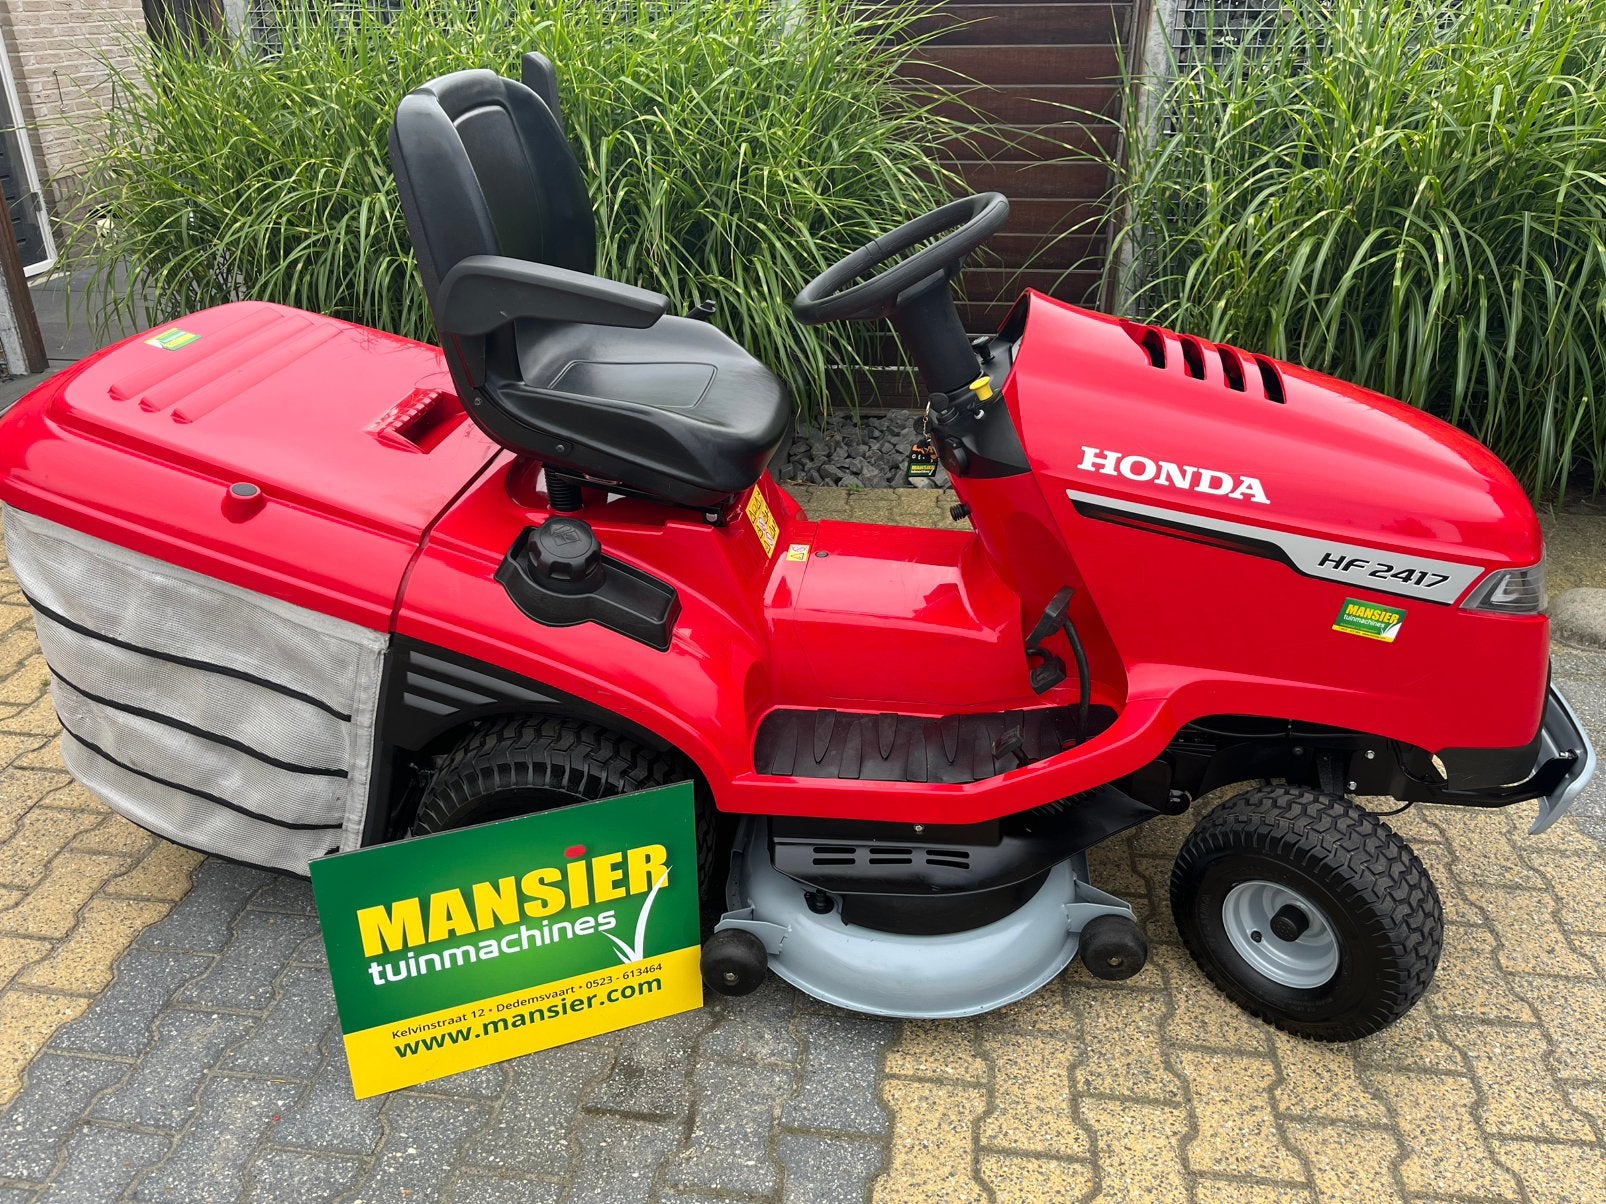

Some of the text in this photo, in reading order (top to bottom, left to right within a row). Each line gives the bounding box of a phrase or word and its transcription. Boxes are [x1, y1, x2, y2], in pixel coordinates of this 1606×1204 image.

[1077, 445, 1271, 505] HONDA
[1317, 552, 1451, 588] HF 2417
[1345, 604, 1400, 624] MANSIER
[356, 844, 669, 958] MANSIER
[368, 909, 616, 986] tuinmachines
[391, 1013, 468, 1040] Kelvinstraat
[471, 1008, 485, 1019] 12
[496, 986, 576, 1013] Dedemsvaart
[585, 975, 613, 990] 0523
[622, 963, 662, 980] 613464
[394, 977, 662, 1058] www.mansier.com
